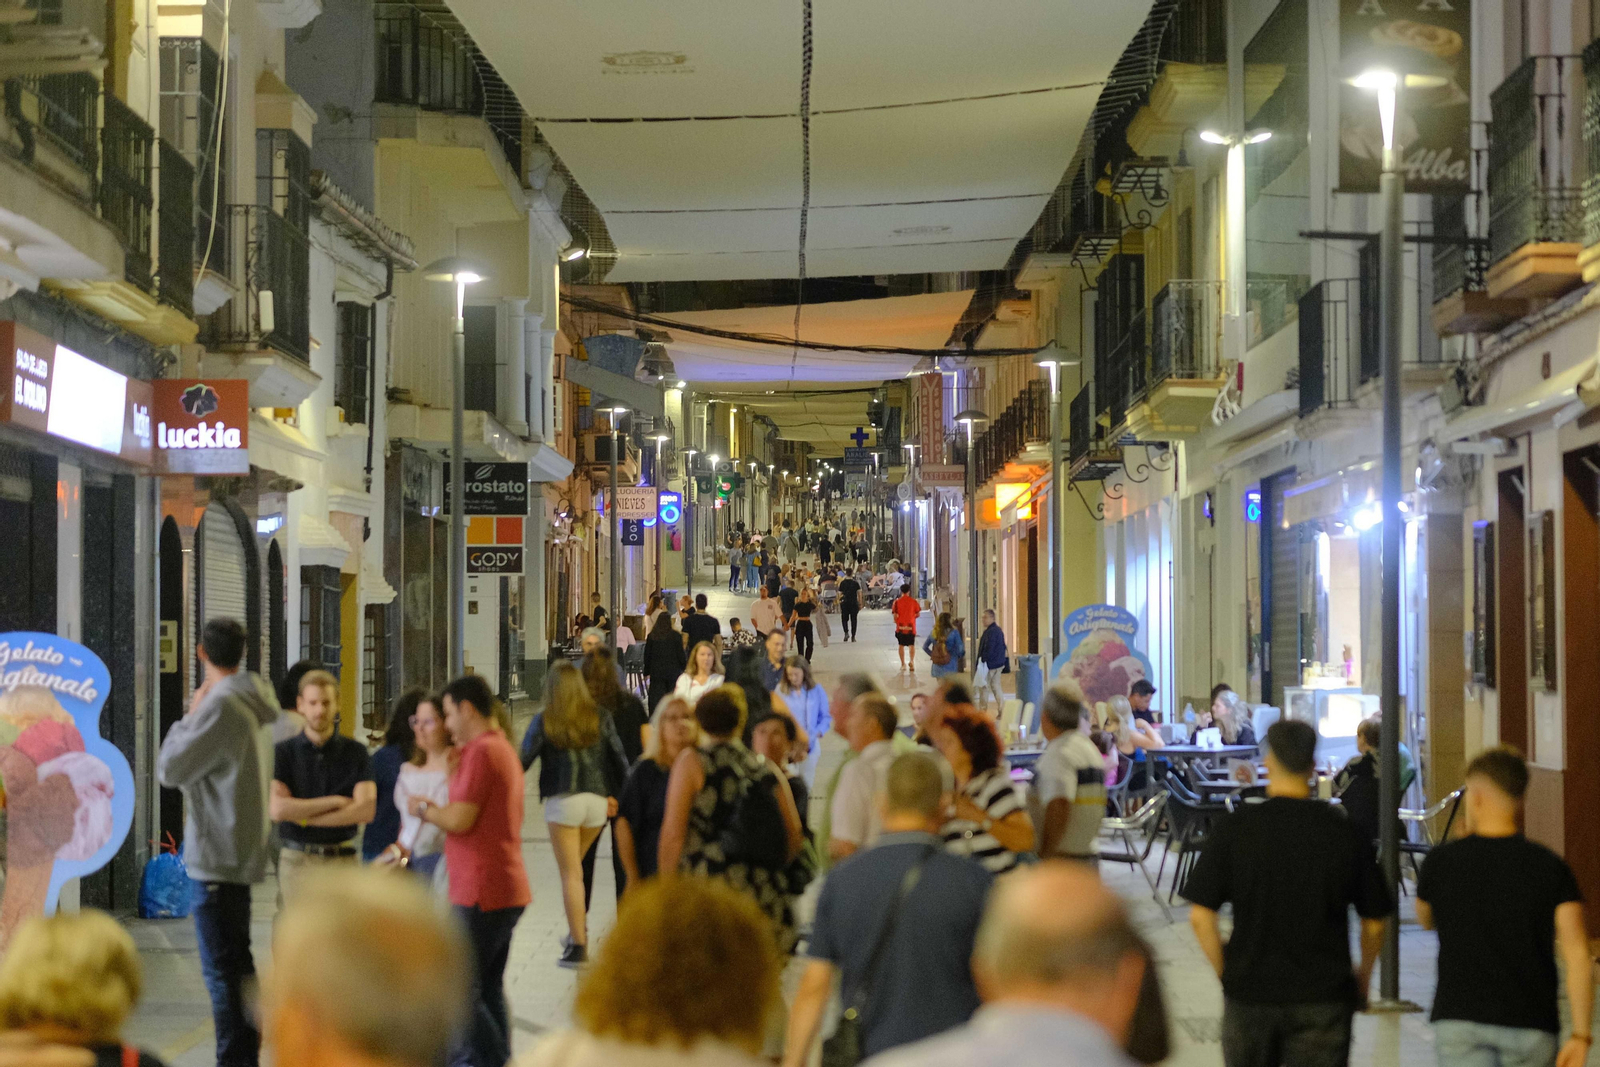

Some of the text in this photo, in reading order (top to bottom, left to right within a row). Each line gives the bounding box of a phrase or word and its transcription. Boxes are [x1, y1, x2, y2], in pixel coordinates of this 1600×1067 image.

[1400, 147, 1468, 180] Alba
[158, 421, 242, 449] luckia
[445, 480, 525, 493] arostato
[616, 497, 646, 510] NIEVES
[470, 552, 519, 566] GODY
[1086, 608, 1118, 621] Gelato
